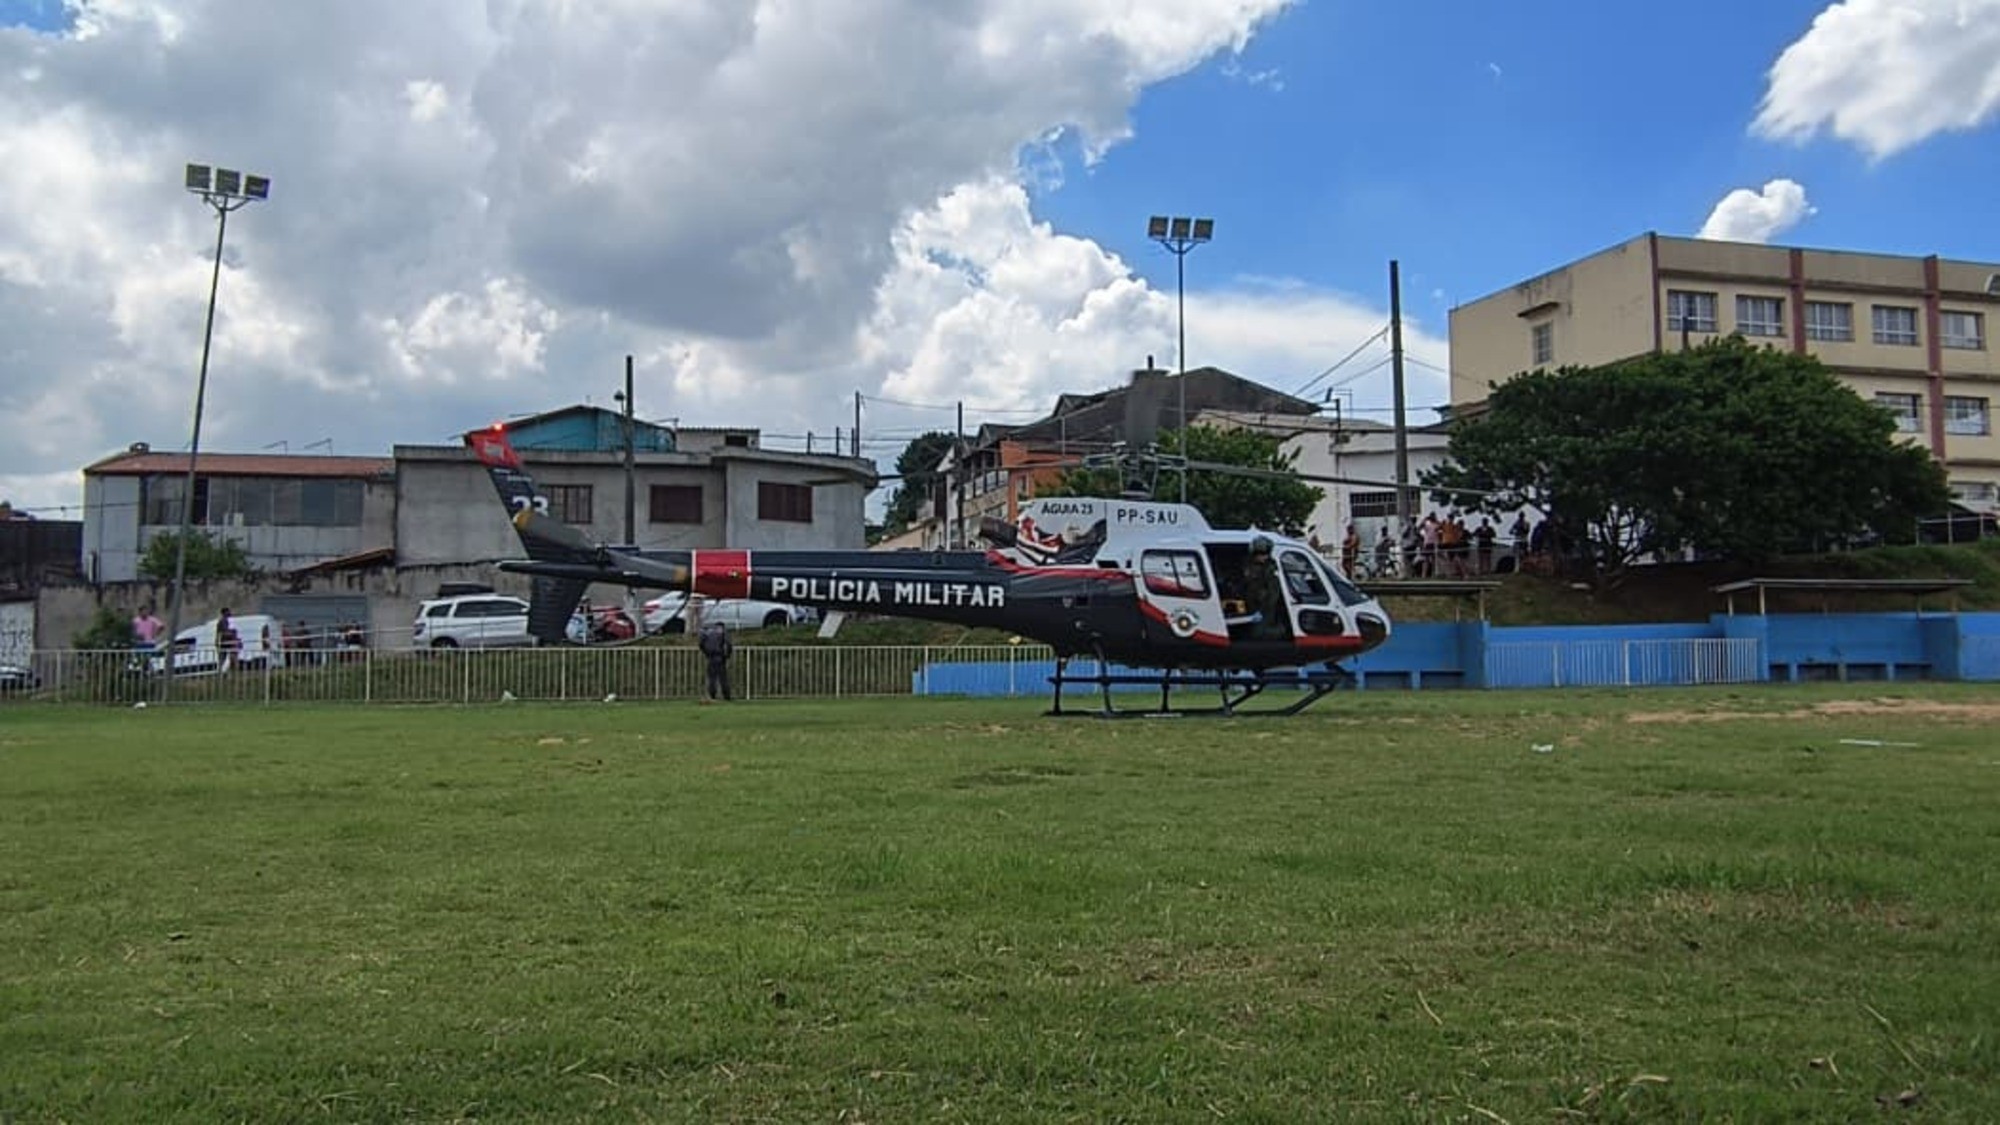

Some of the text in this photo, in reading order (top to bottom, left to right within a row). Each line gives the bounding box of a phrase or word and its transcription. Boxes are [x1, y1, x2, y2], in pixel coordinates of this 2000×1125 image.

[1117, 508, 1178, 524] PP-SAU
[771, 572, 1005, 607] POLÍCIA MILITAR
